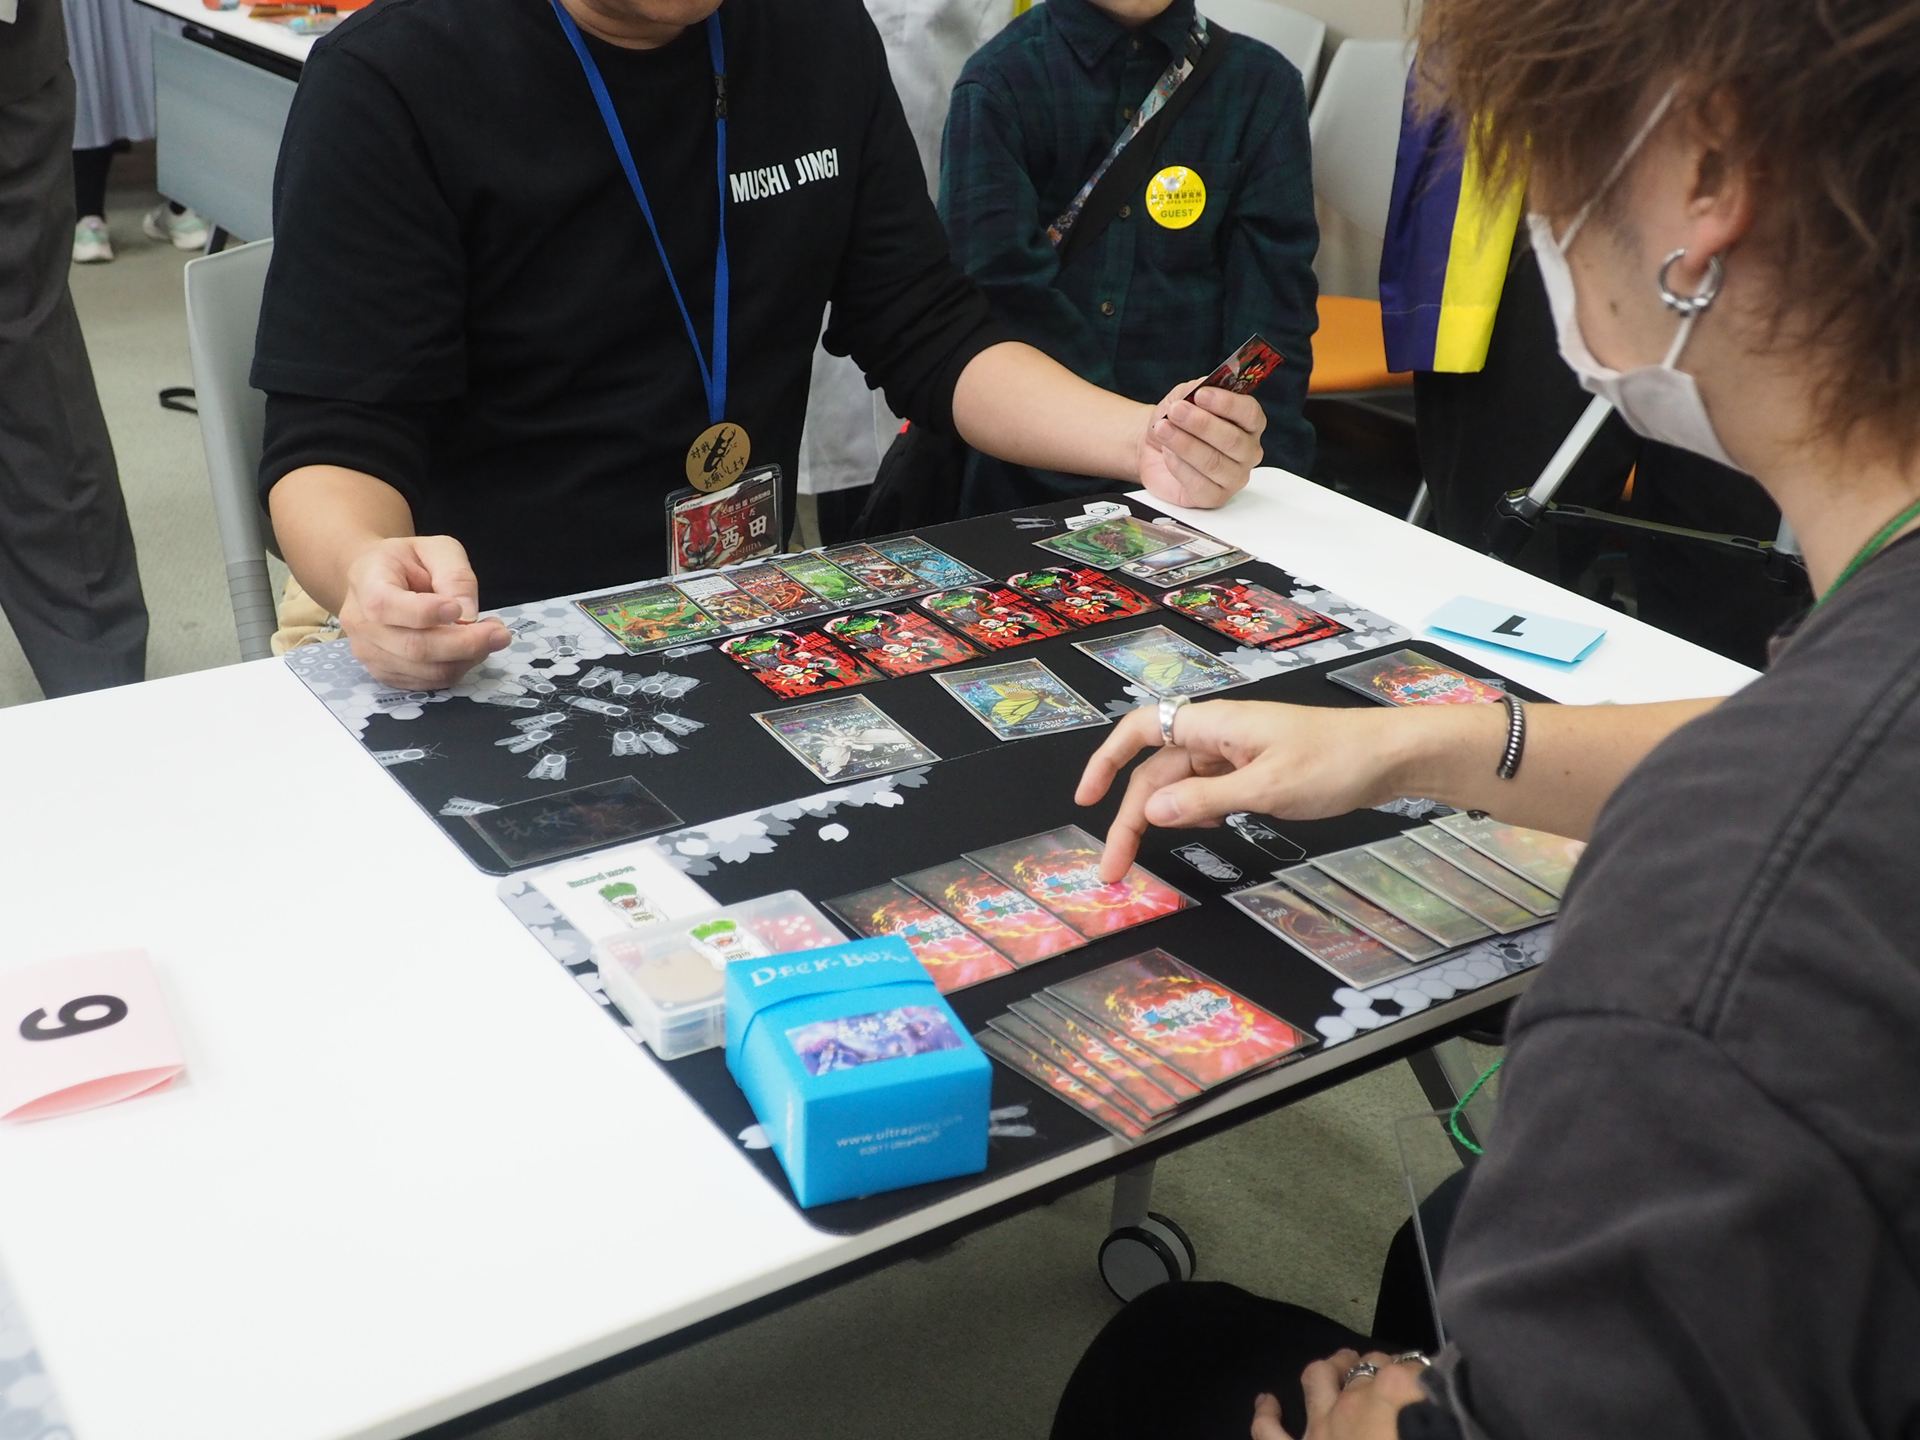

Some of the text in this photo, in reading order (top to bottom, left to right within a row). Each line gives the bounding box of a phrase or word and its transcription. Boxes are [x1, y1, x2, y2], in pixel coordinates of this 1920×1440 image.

[729, 147, 839, 203] MUSHI JINGI
[1160, 208, 1193, 218] GUEST
[720, 514, 767, 550] 西田
